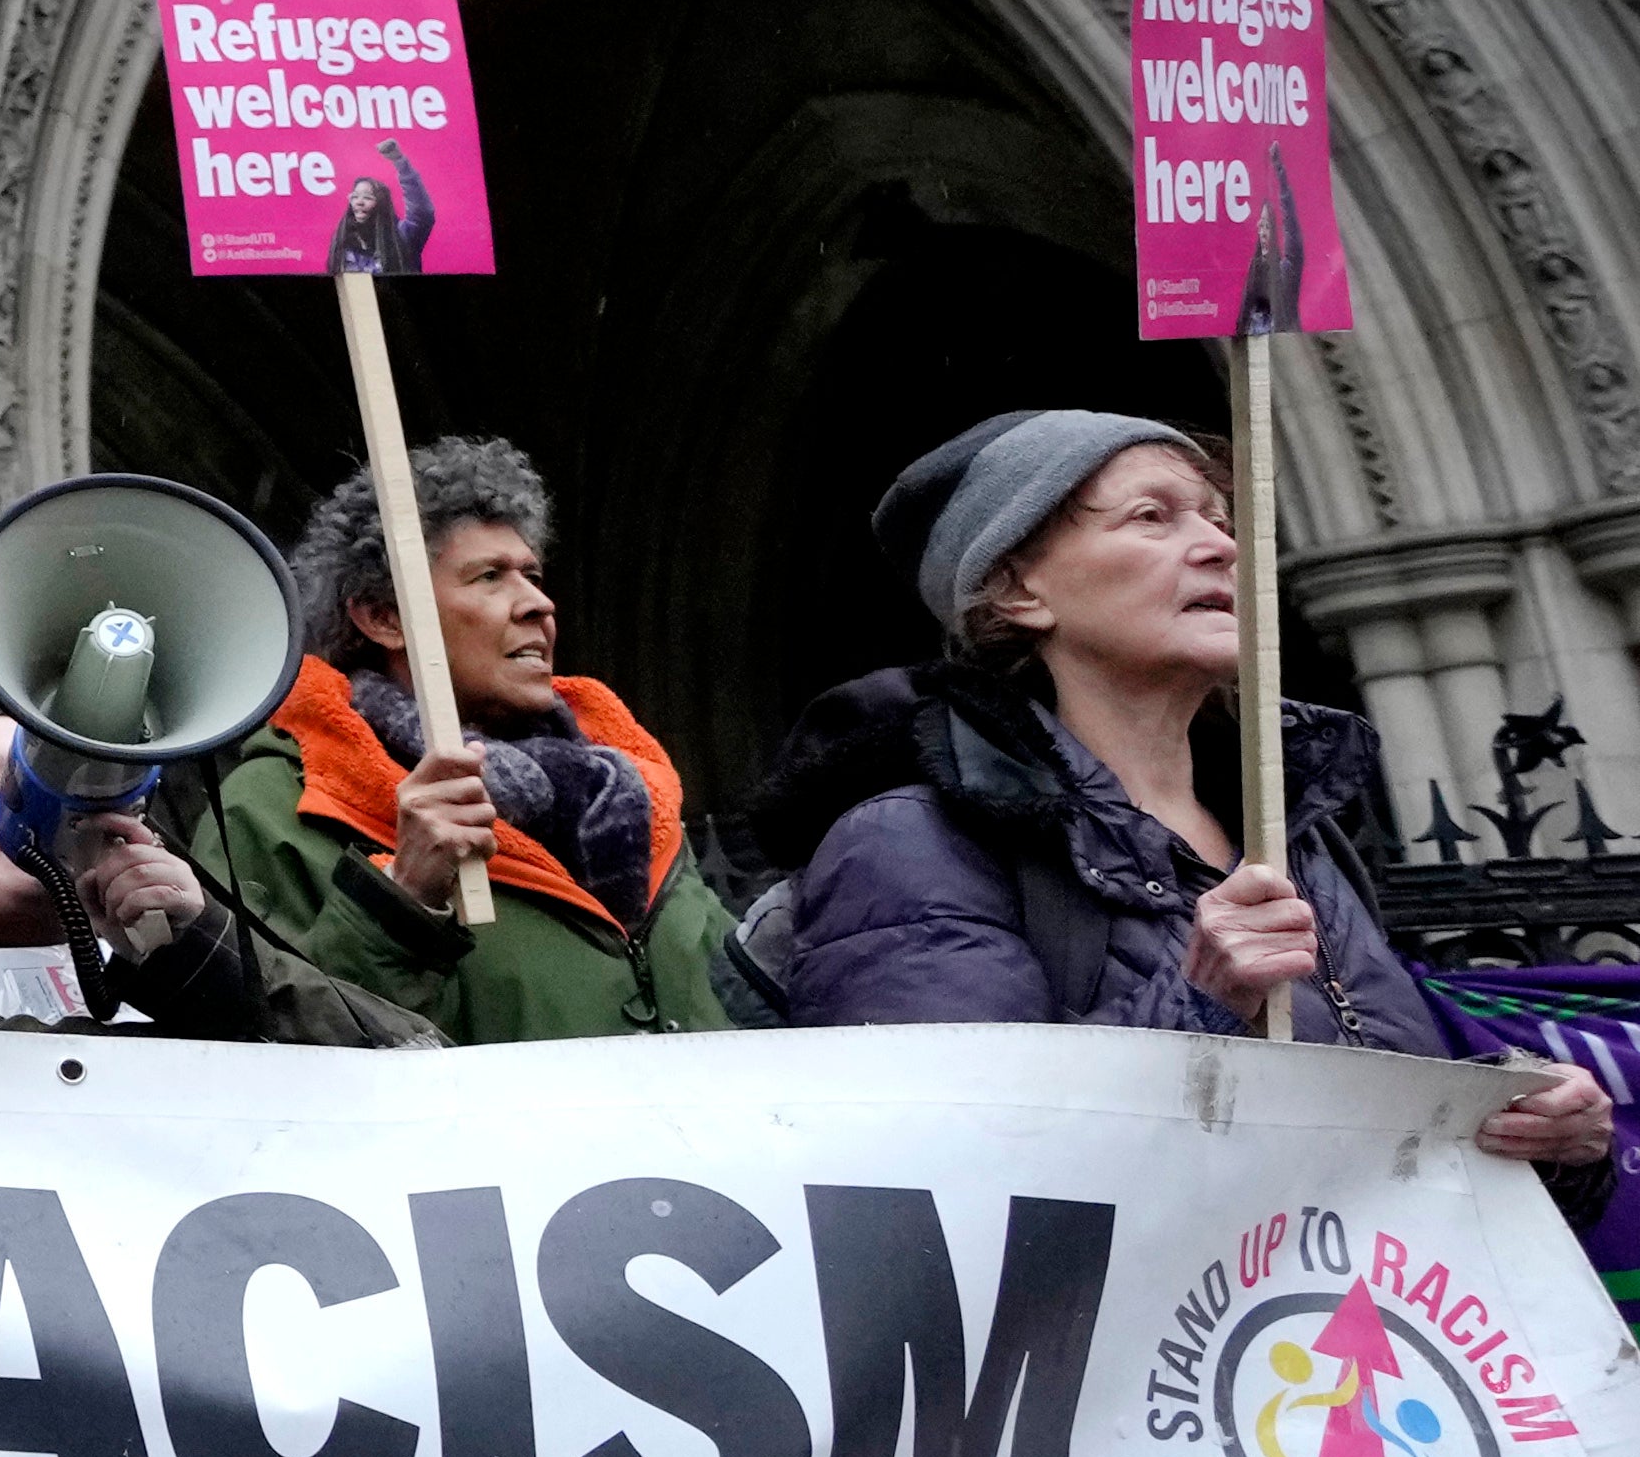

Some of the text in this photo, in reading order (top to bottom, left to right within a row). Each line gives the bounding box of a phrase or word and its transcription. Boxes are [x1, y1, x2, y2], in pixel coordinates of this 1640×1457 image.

[173, 3, 450, 76] Refugees
[183, 68, 447, 129] welcome
[1142, 37, 1309, 126] welcome
[193, 138, 336, 196] here
[1145, 137, 1251, 223] here
[1146, 1205, 1580, 1443] STAND UP TO RACISM
